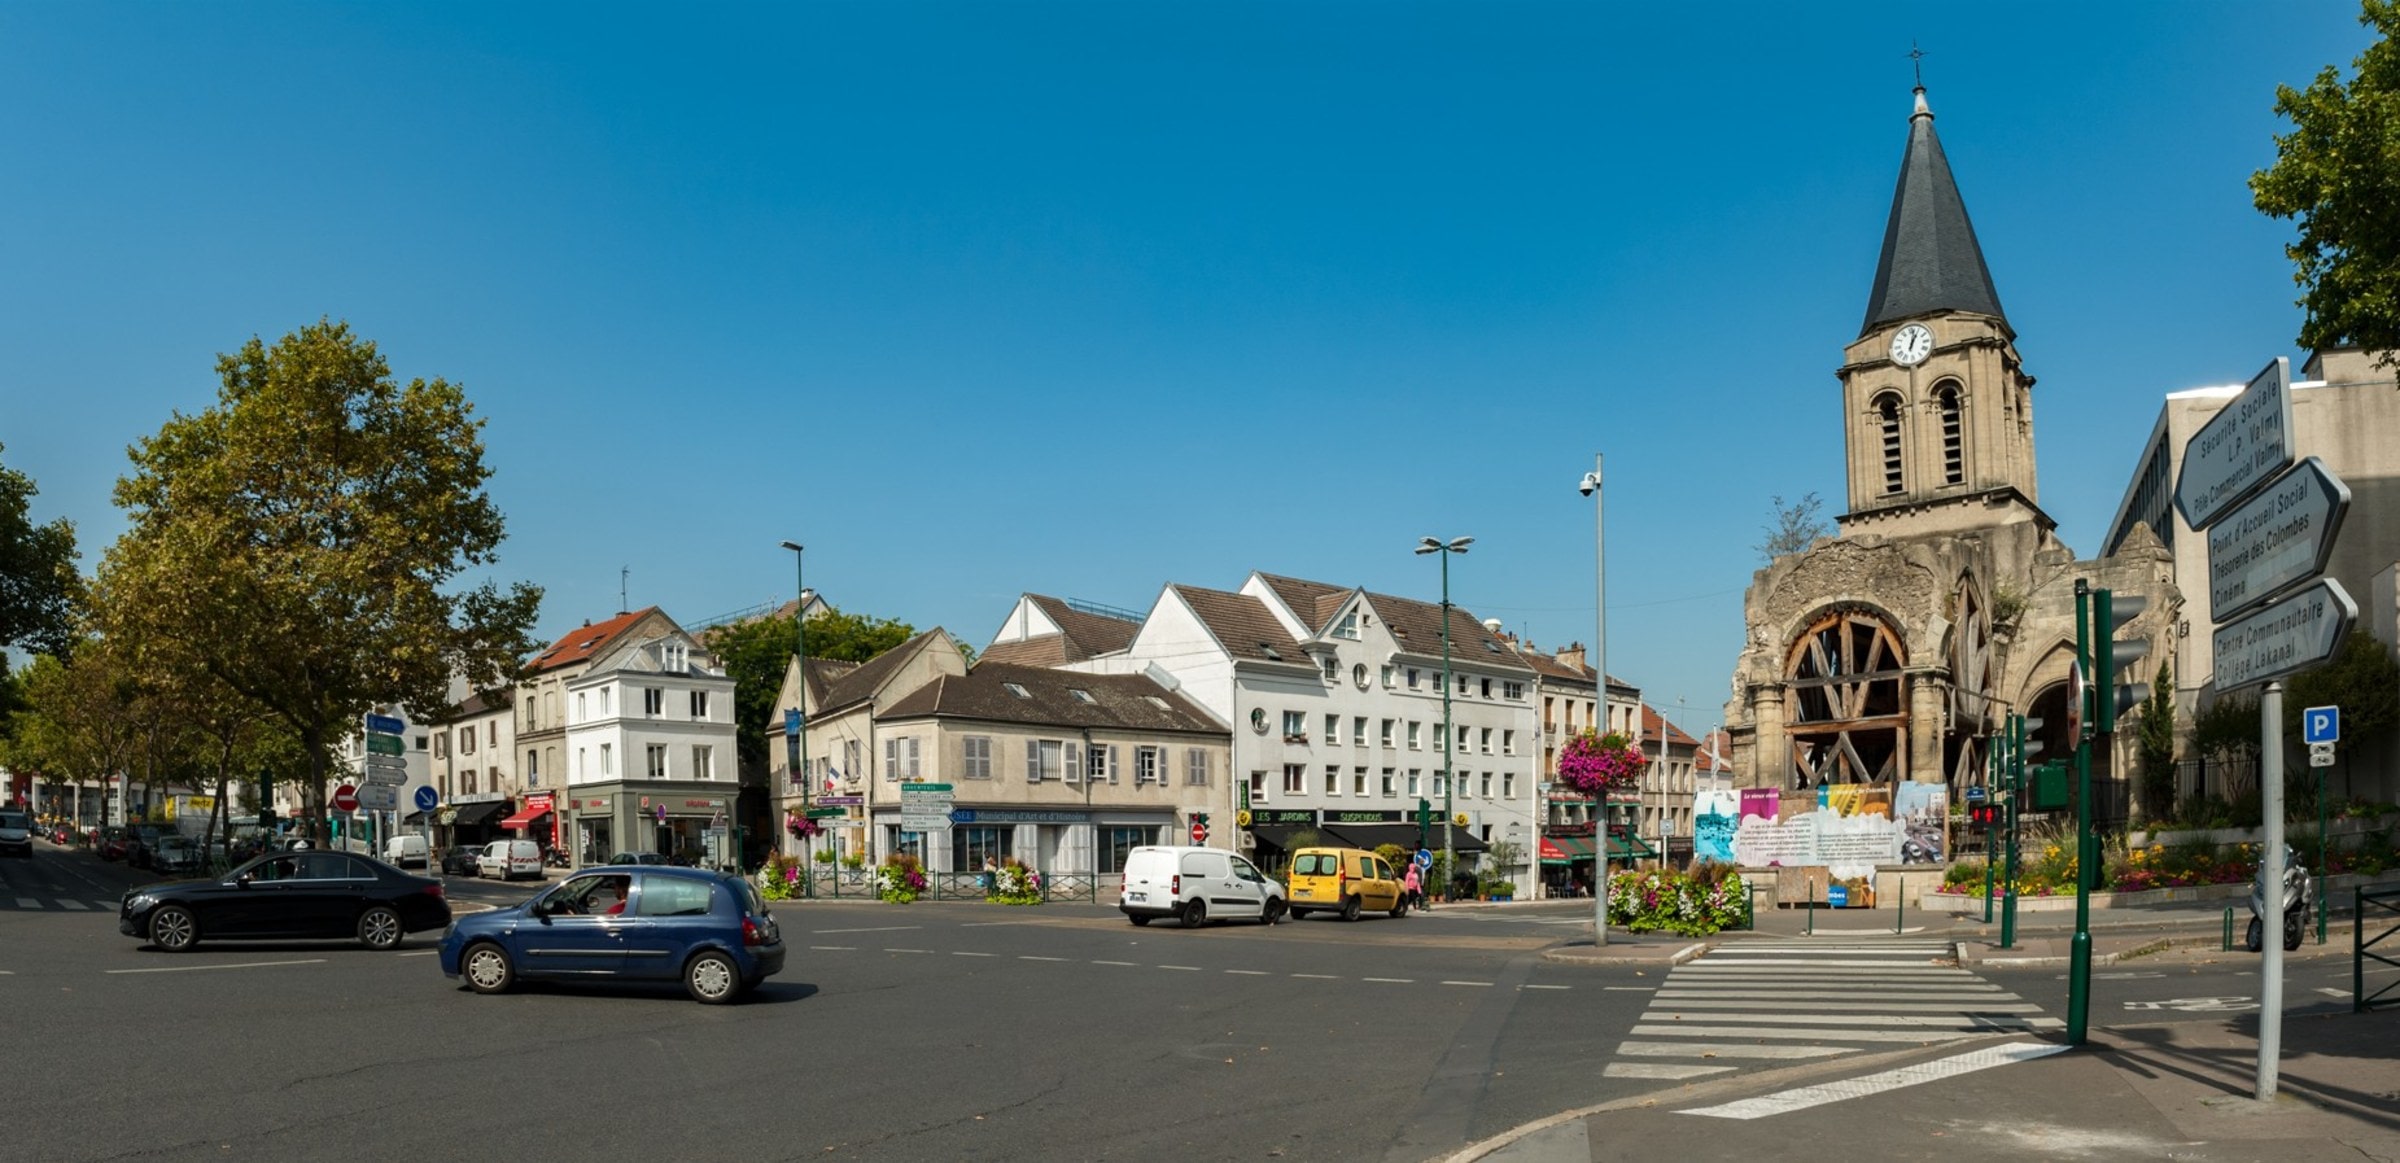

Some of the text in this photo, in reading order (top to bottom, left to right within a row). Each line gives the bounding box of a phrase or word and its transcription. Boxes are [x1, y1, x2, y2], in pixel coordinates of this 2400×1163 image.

[2201, 381, 2277, 459] Sécurité Sociale
[2228, 410, 2279, 462] L.P. Valmy
[2194, 438, 2281, 516] Pôle Commercial Valmy
[2213, 477, 2308, 557] Point d'Accueil Social
[2214, 513, 2309, 581] Trésorerie des Colombes
[2215, 580, 2245, 608] Cinéma
[2217, 600, 2323, 657] Centre Communautaire
[2217, 637, 2295, 682] Collège Lakanal
[2314, 715, 2330, 737] P
[976, 811, 1016, 821] Municipal
[1020, 811, 1037, 820] d'Art
[1255, 812, 1312, 822] LES JARDINS
[1340, 813, 1383, 821] SUSPENDUS
